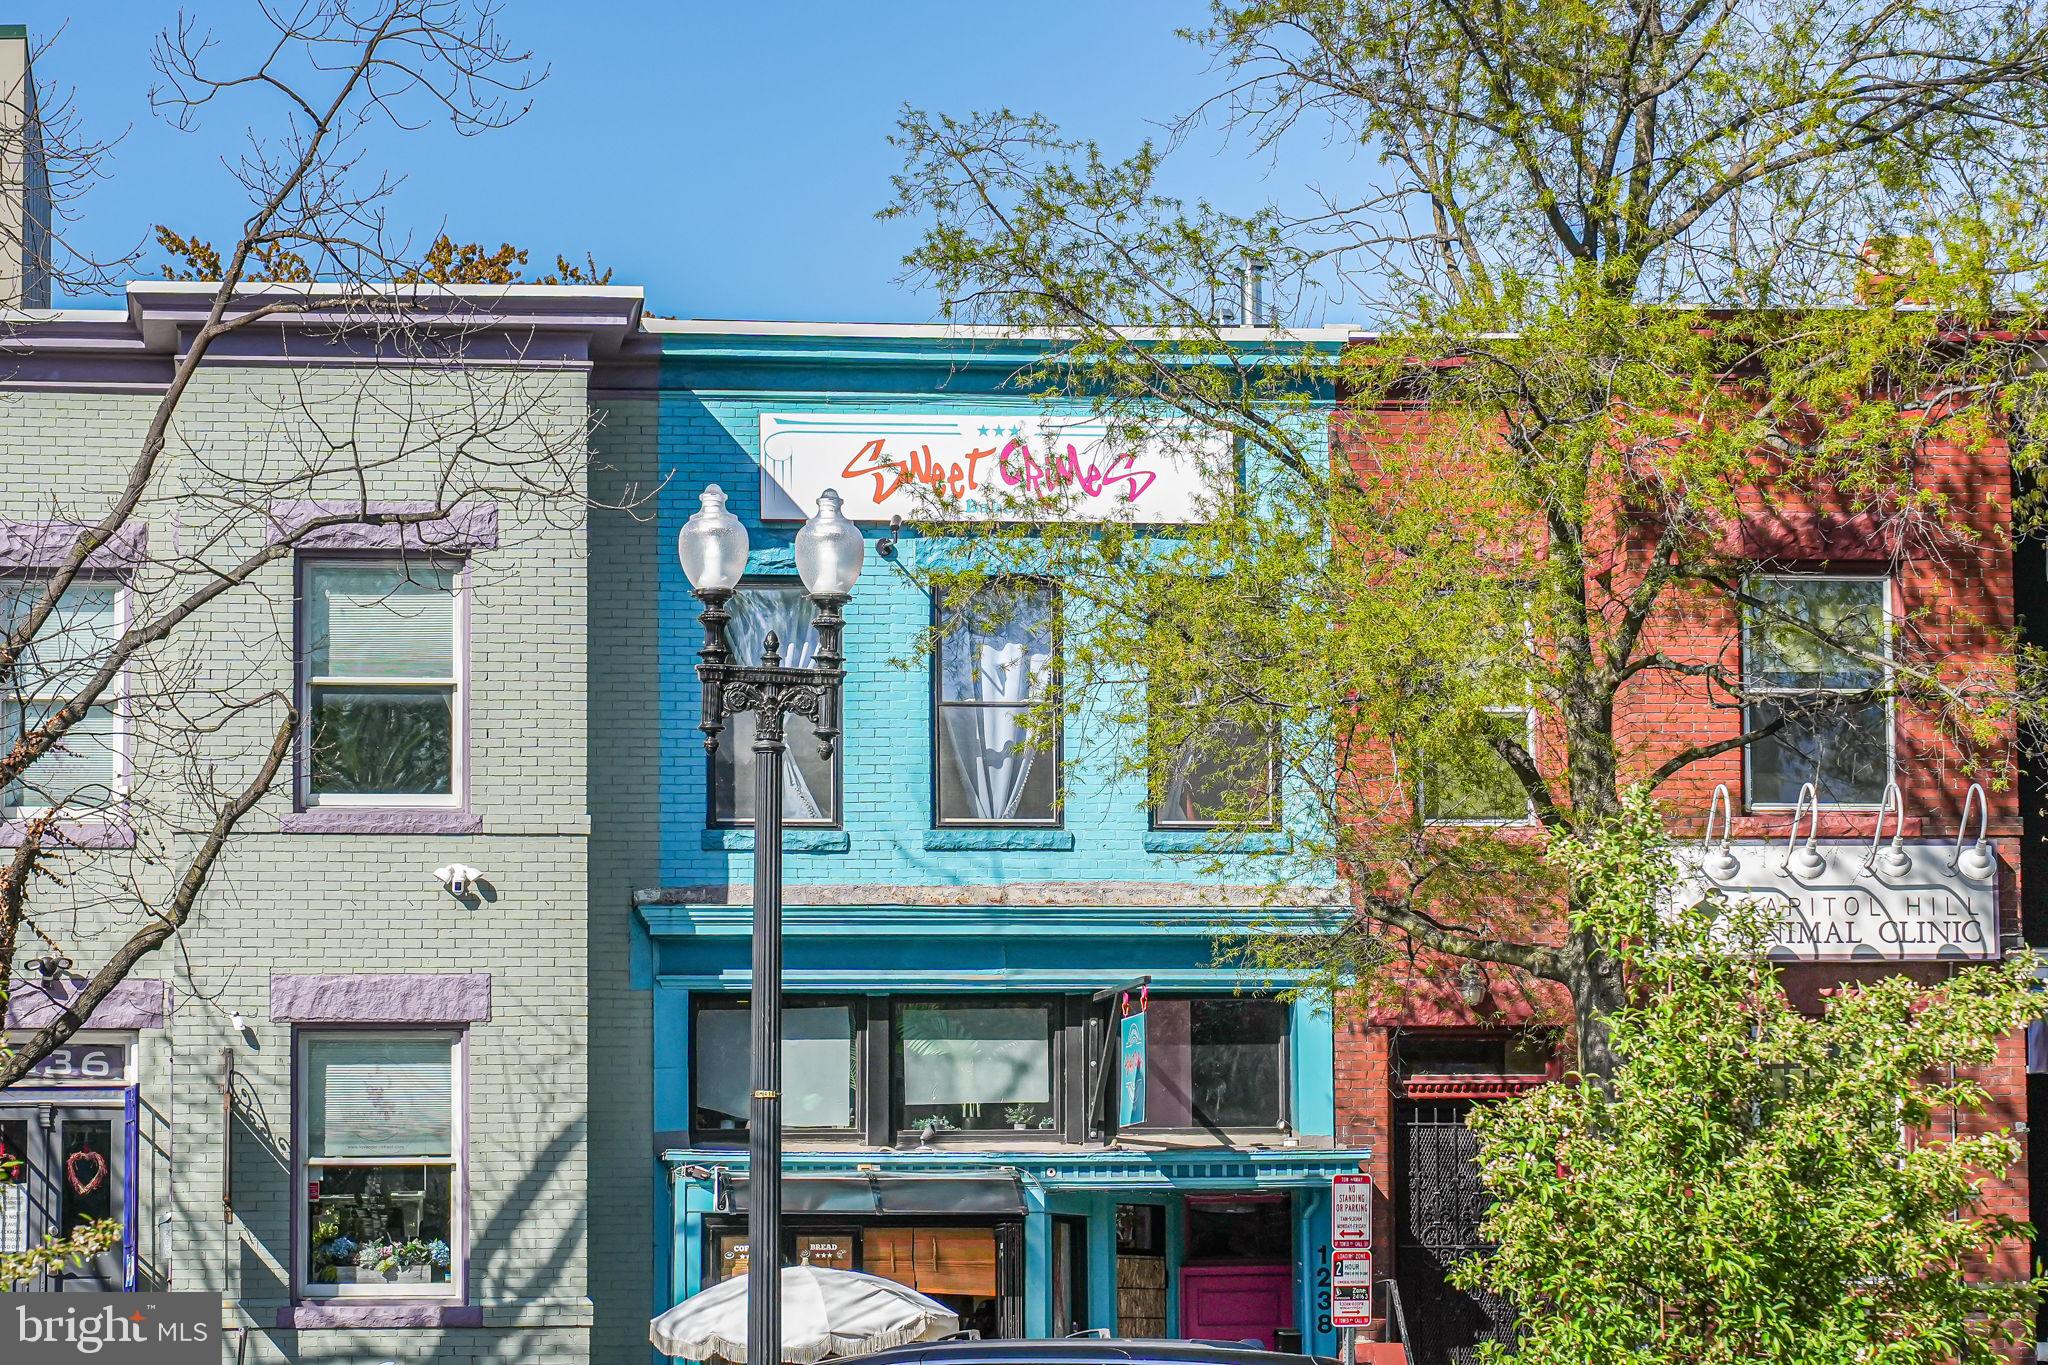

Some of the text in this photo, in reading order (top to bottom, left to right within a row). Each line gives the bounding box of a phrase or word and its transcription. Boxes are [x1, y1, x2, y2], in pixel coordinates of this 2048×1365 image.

[1907, 897, 1979, 916] HILL
[1752, 921, 1982, 943] NIMAL CLINIC
[1348, 1185, 1356, 1193] NO
[1339, 1194, 1365, 1203] STANDING
[1336, 1204, 1368, 1212] OR PARKING
[809, 1243, 838, 1251] BREAD
[1335, 1261, 1342, 1276] 2
